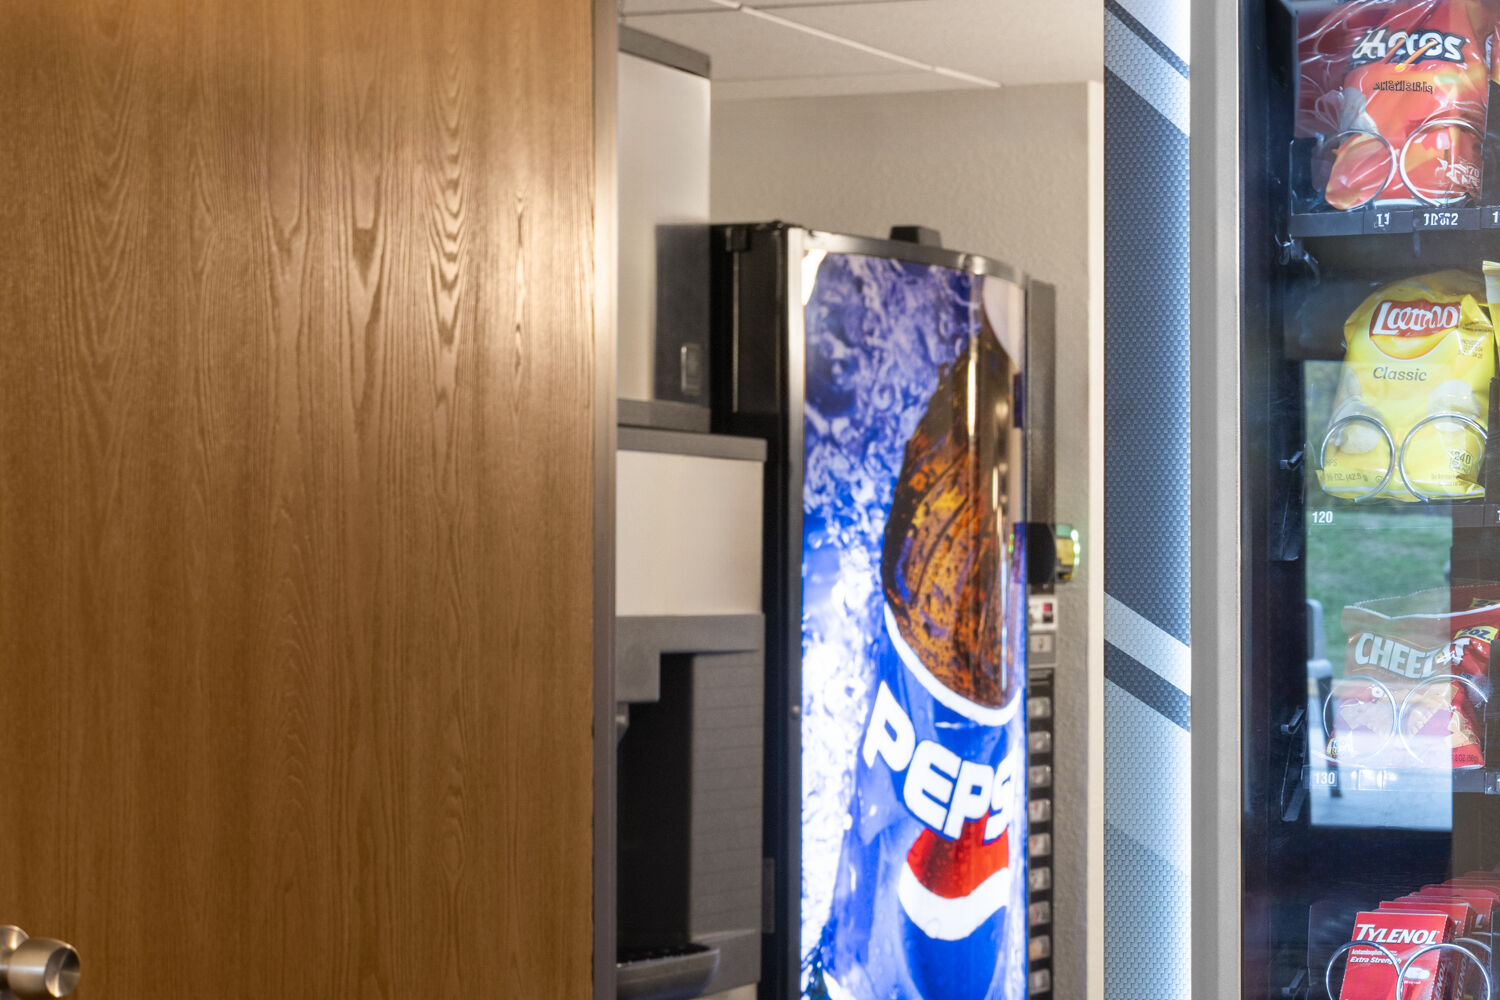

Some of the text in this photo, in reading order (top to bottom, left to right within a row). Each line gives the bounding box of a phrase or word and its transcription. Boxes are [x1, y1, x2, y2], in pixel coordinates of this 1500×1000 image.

[1372, 366, 1428, 383] Classic
[1312, 510, 1333, 524] 120
[1315, 773, 1335, 785] 130
[1356, 924, 1437, 945] TYLENOL
